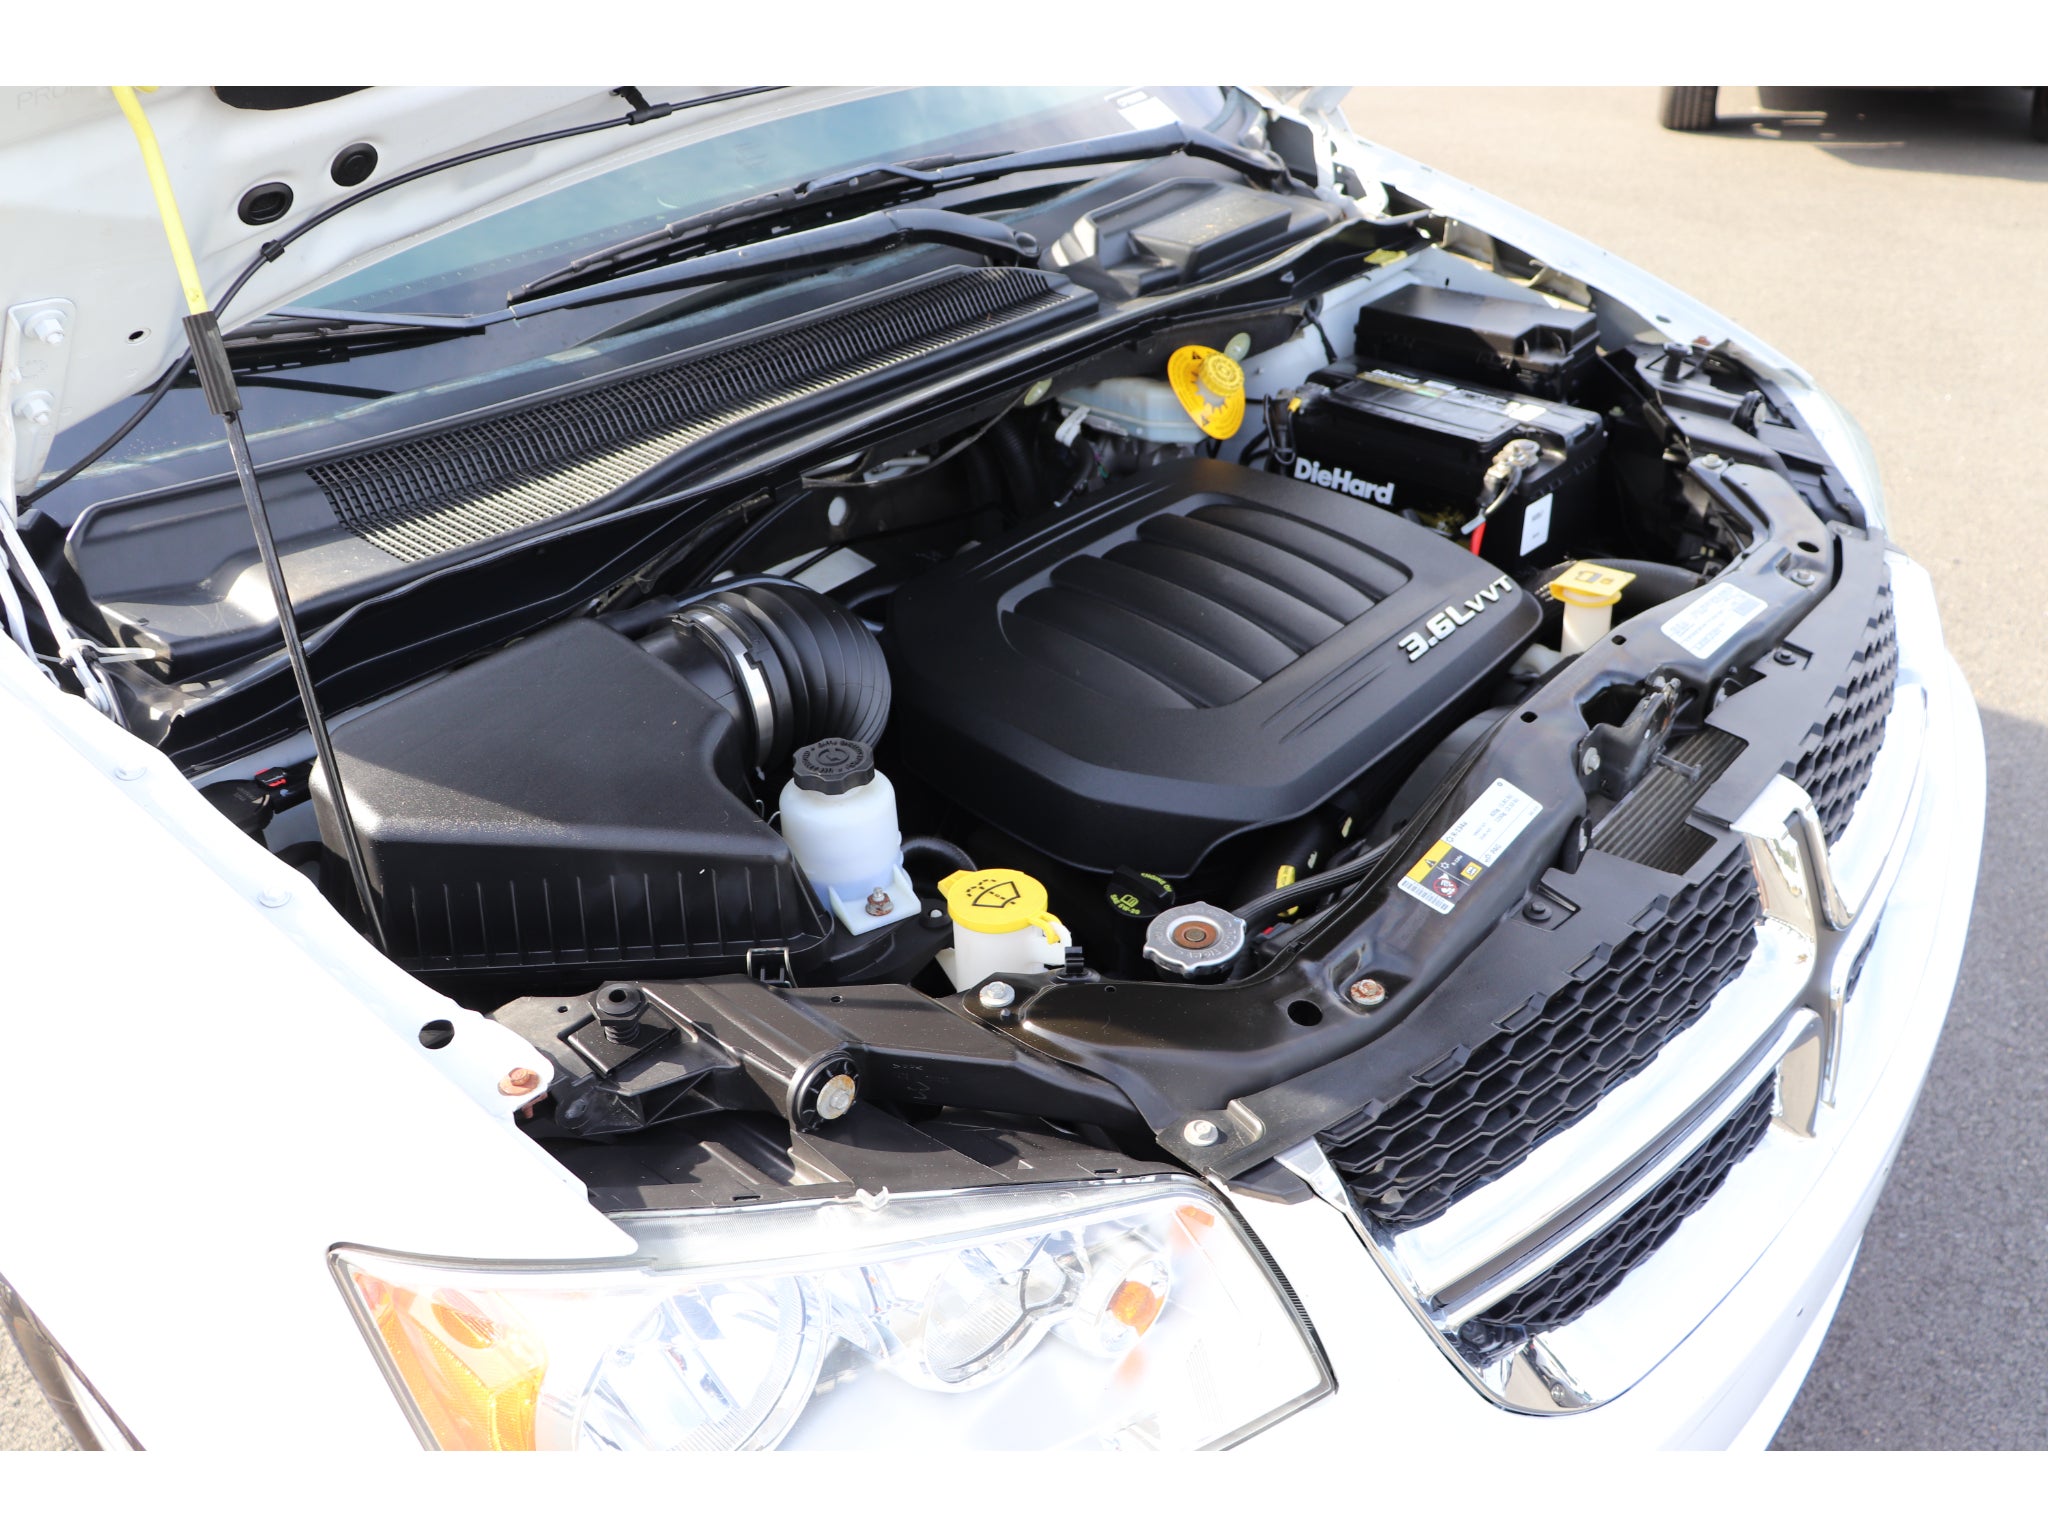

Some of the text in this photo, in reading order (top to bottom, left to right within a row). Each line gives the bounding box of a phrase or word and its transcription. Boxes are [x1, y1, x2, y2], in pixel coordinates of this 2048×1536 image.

[1293, 456, 1395, 506] DieHard
[1398, 574, 1513, 663] 3.6L VVT
